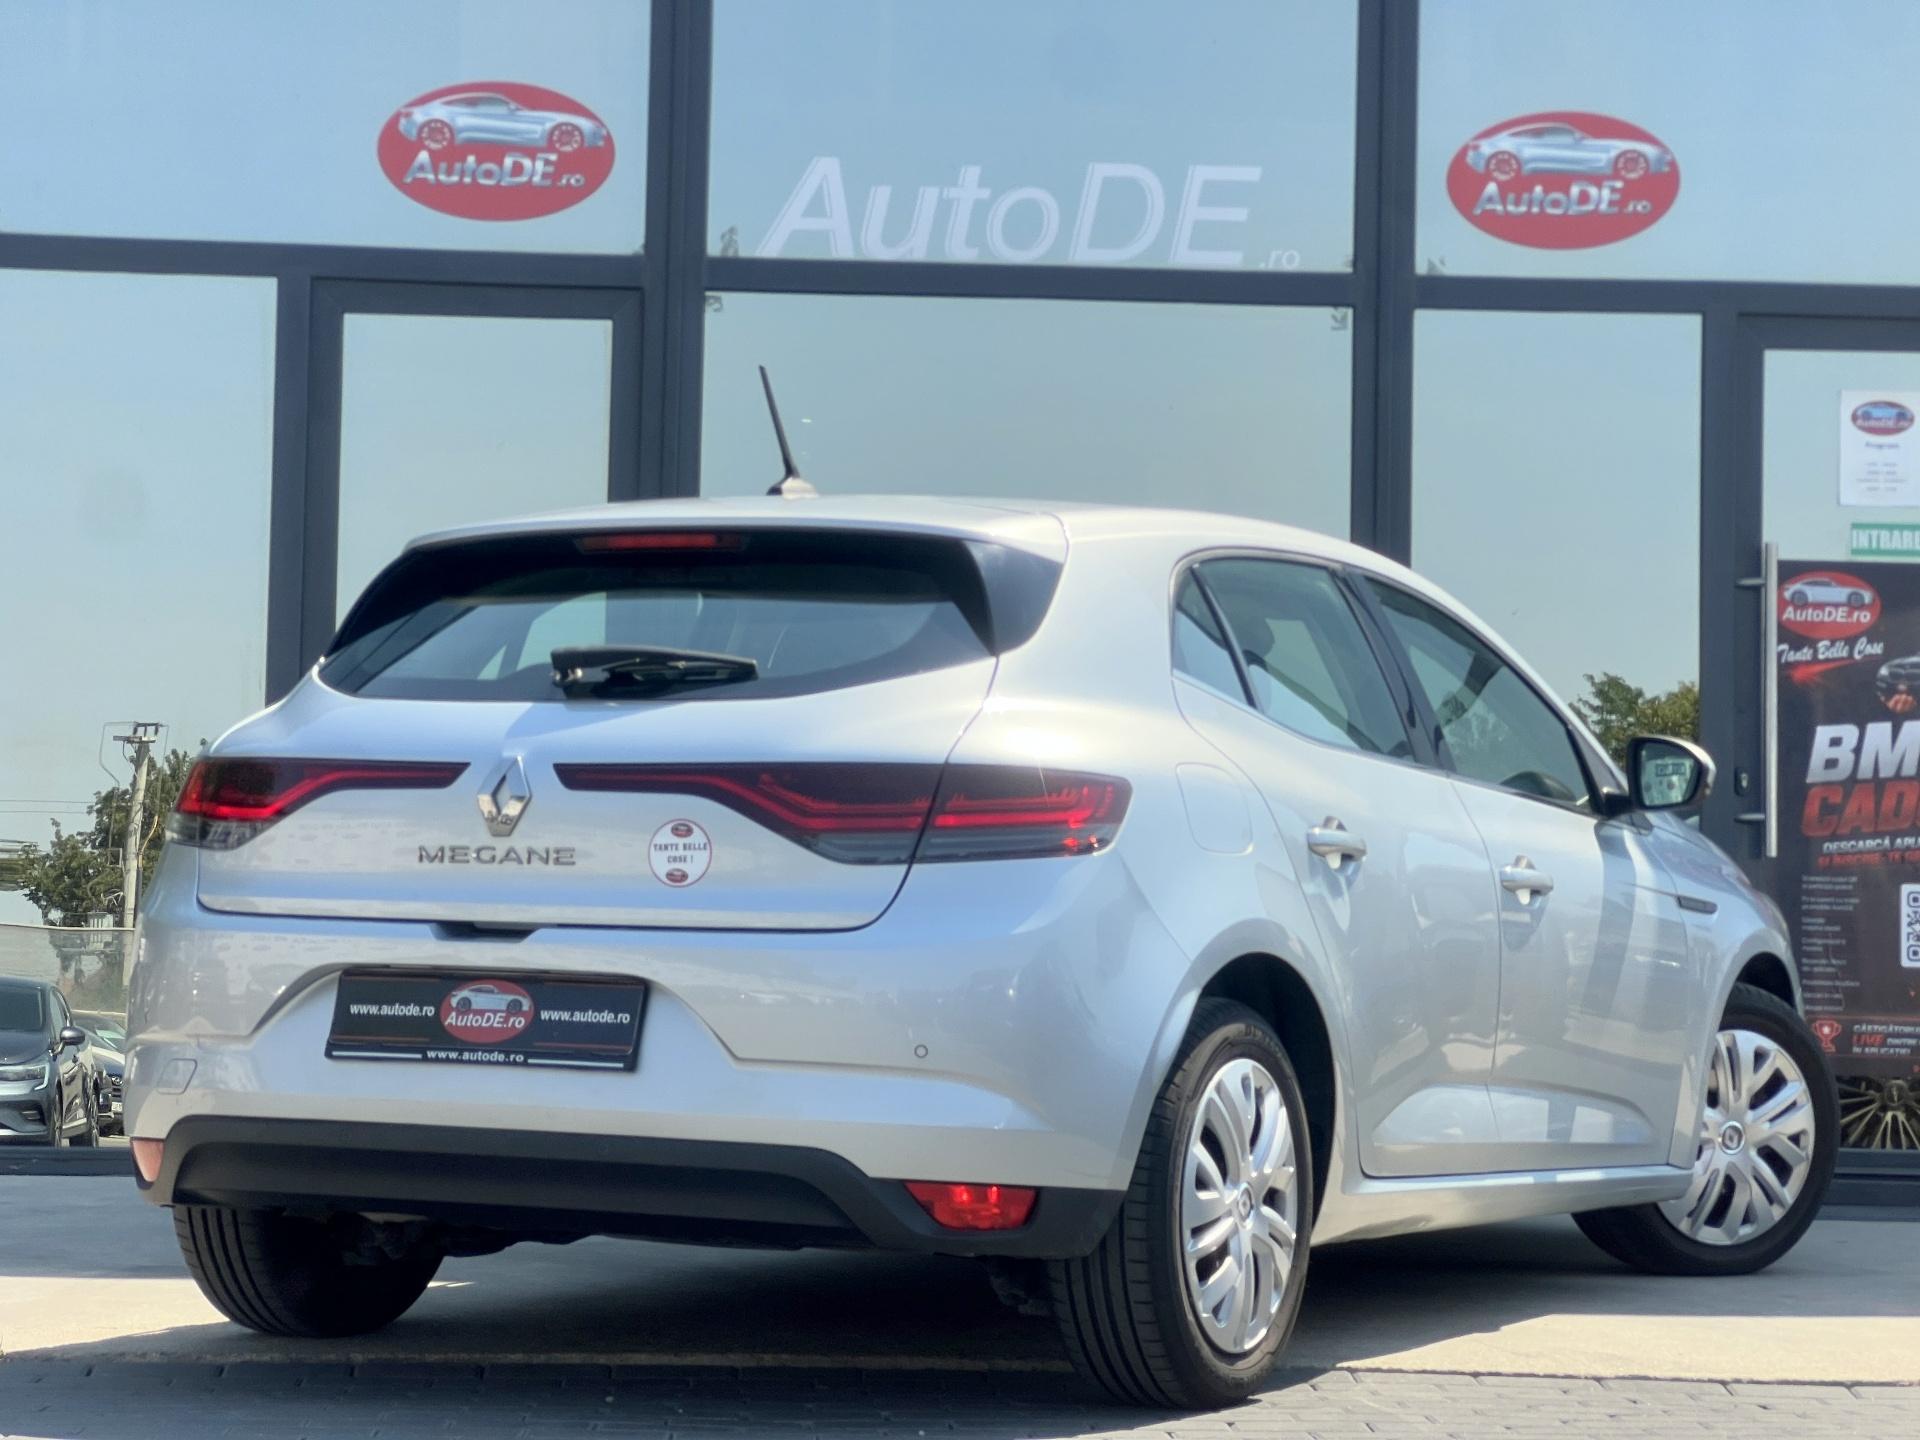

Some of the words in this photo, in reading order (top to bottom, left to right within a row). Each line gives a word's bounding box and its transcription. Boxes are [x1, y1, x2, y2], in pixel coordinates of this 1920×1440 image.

[1782, 605, 1872, 624] AutoDE.ro
[1817, 640, 1850, 660] Belle
[1854, 636, 1885, 660] Cose
[1802, 780, 1920, 837] CAD
[418, 845, 577, 867] MEGANE
[653, 842, 680, 852] TANTE
[682, 842, 707, 852] BELLE
[667, 854, 687, 864] COSE
[349, 1003, 436, 1017] www.autode.ro
[444, 1011, 526, 1029] AutoDE.ro
[540, 1009, 631, 1024] www.autode.ro
[426, 1049, 525, 1064] www.autode.ro
